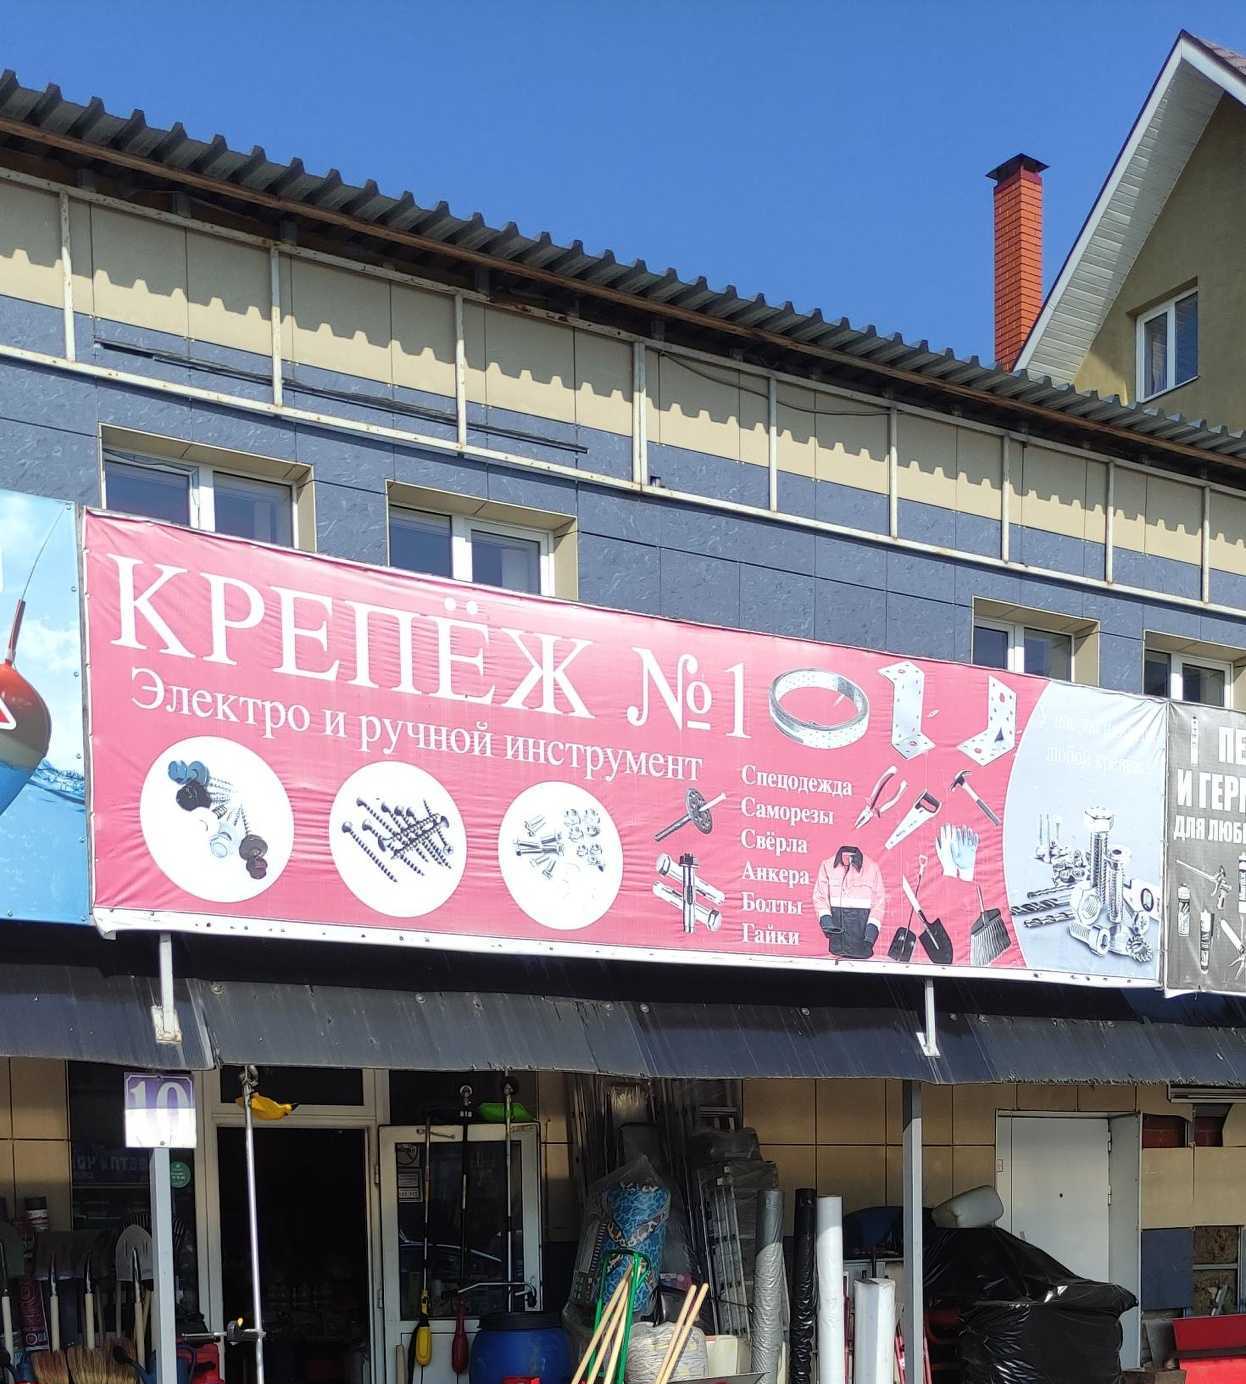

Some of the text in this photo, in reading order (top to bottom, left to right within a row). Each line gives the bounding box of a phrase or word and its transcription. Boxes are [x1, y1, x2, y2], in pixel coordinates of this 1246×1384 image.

[106, 553, 752, 739] КРЕПЁЖ №1
[131, 667, 703, 781] Электро и ручной инструмент
[742, 764, 852, 798] Спецодежда
[1177, 768, 1193, 807] И
[741, 796, 834, 826] Саморезы
[741, 828, 808, 856] Свёрла
[1173, 814, 1246, 844] ДЛЯ ЛЮБ
[742, 860, 810, 888] Анкера
[741, 891, 803, 915] Болты
[742, 923, 800, 945] Гайки
[129, 1080, 191, 1143] 10
